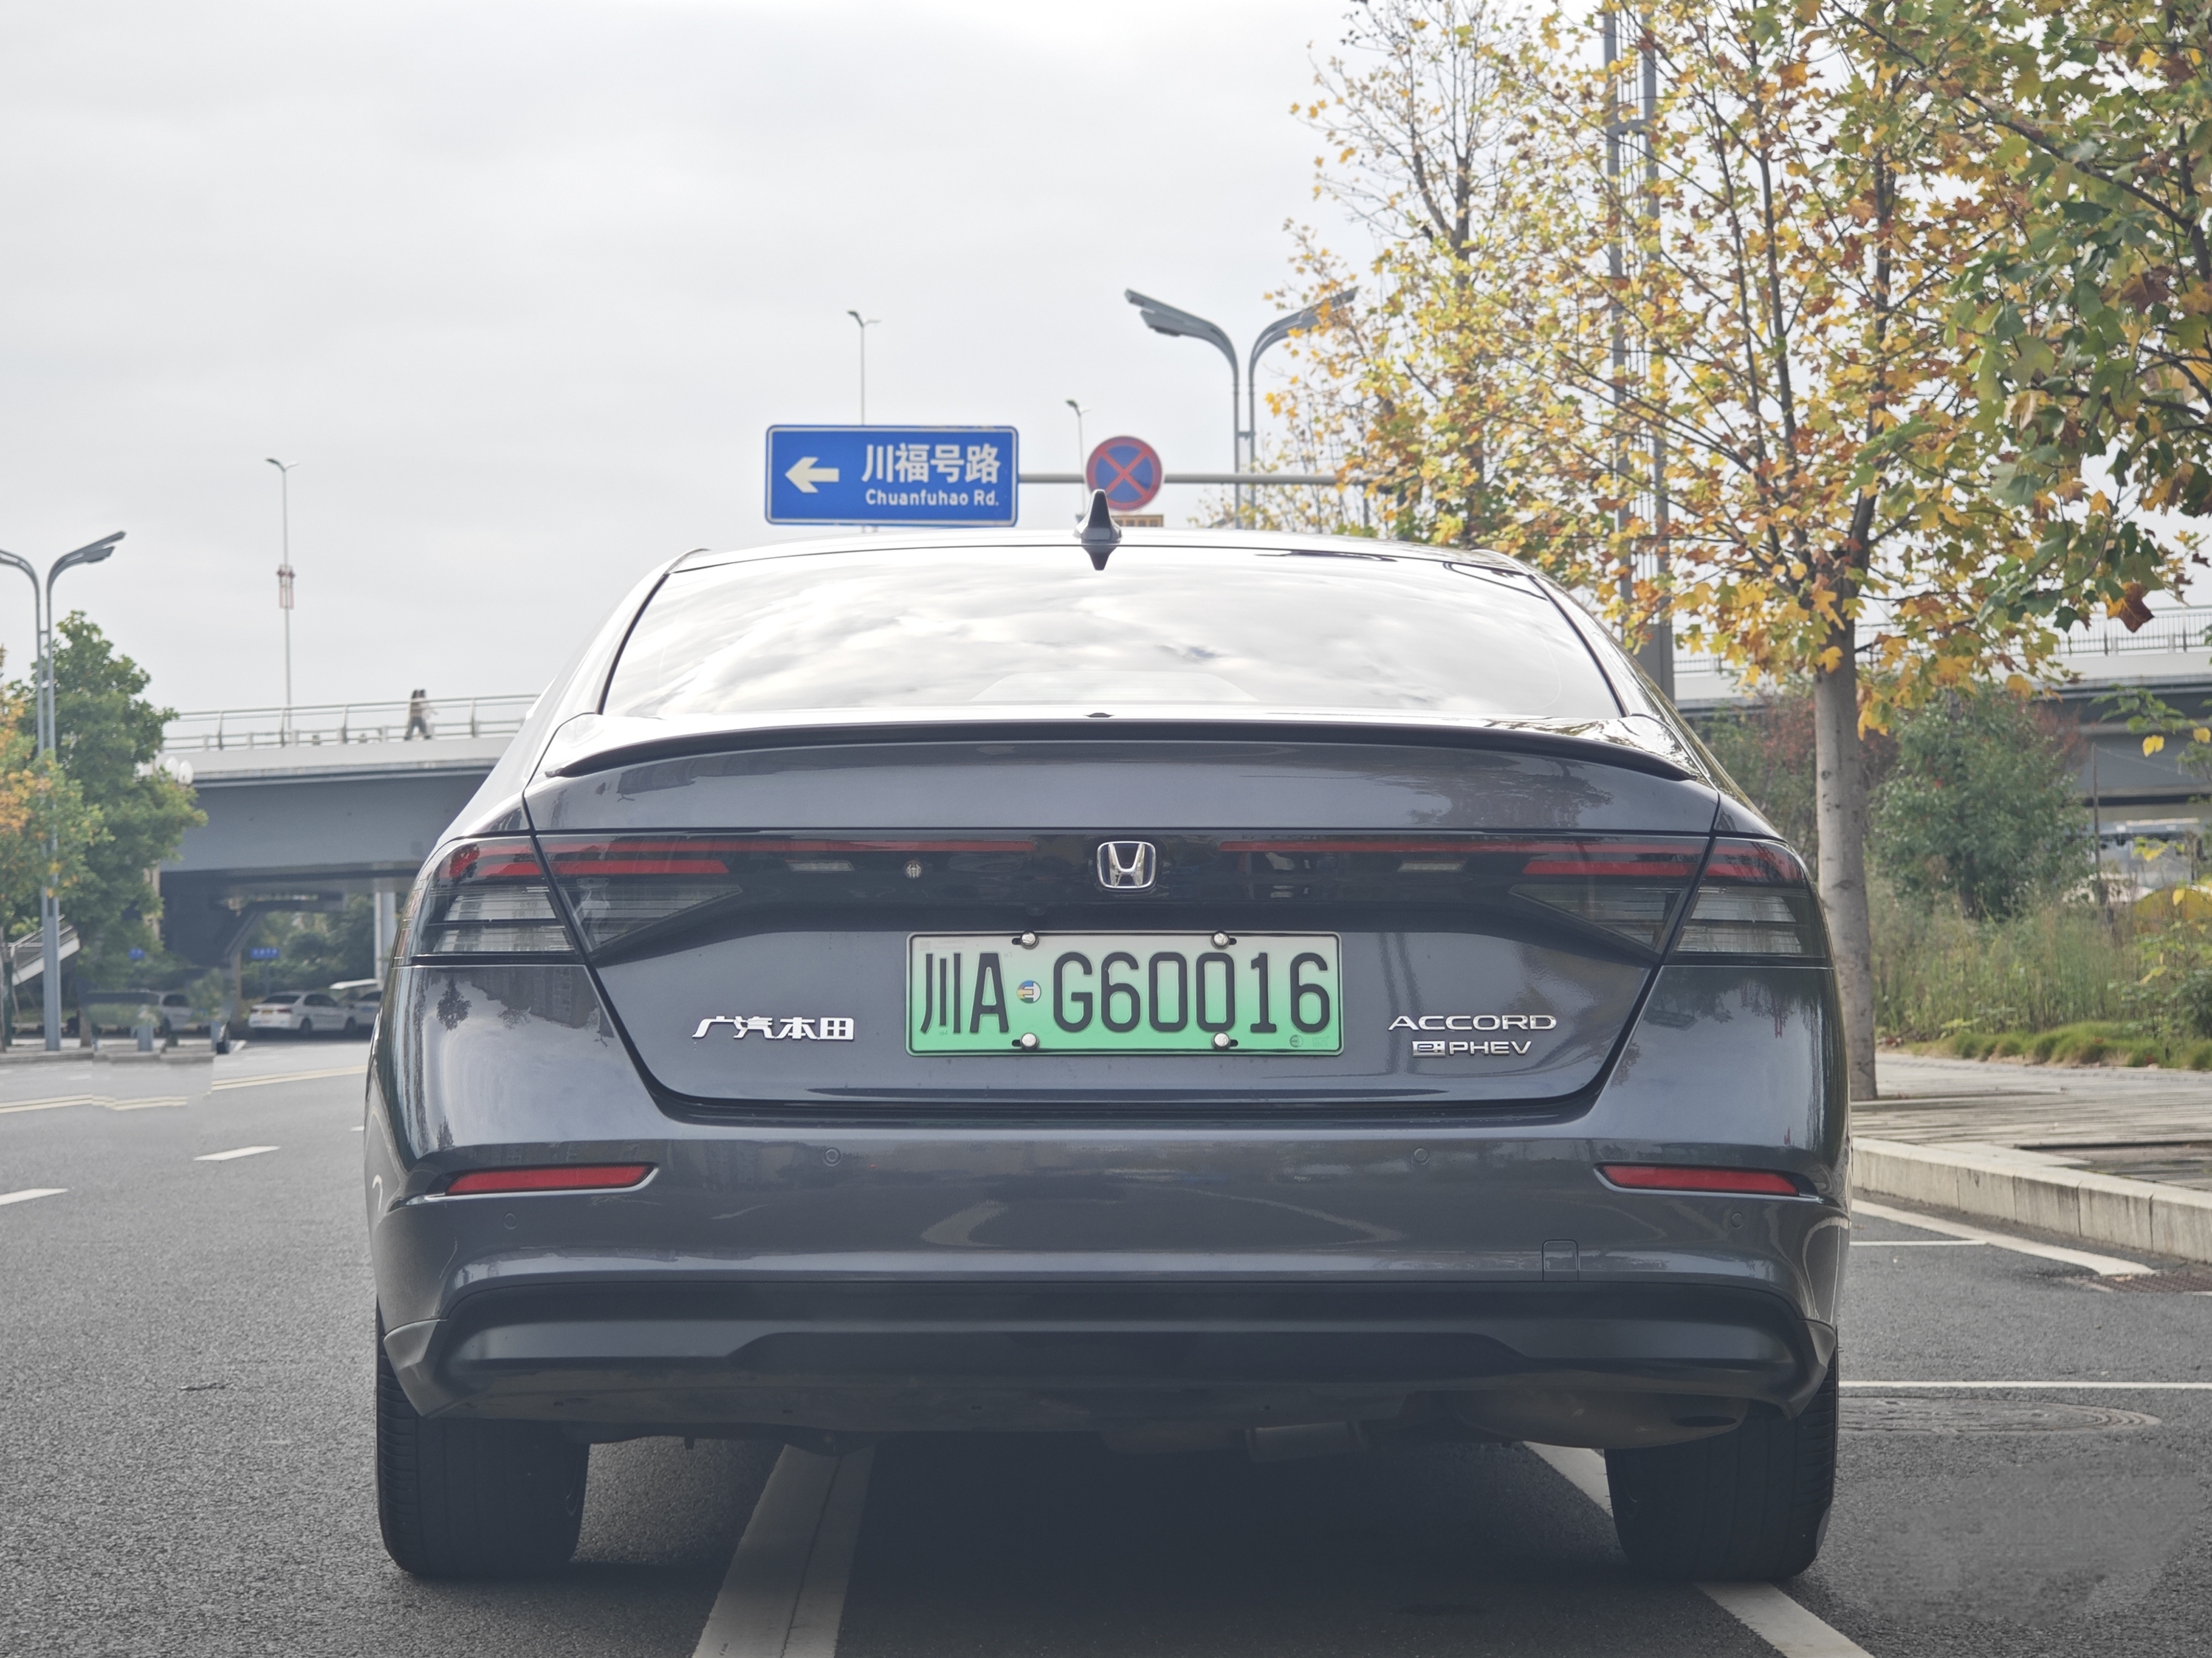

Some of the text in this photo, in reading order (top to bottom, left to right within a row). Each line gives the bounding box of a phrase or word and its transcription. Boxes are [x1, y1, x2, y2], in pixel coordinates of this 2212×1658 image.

[862, 442, 1000, 484] 川福号路
[865, 489, 999, 505] Chuanfuhao Rd.
[692, 1016, 854, 1040] 广汽本田
[1388, 1015, 1557, 1031] ACCORD
